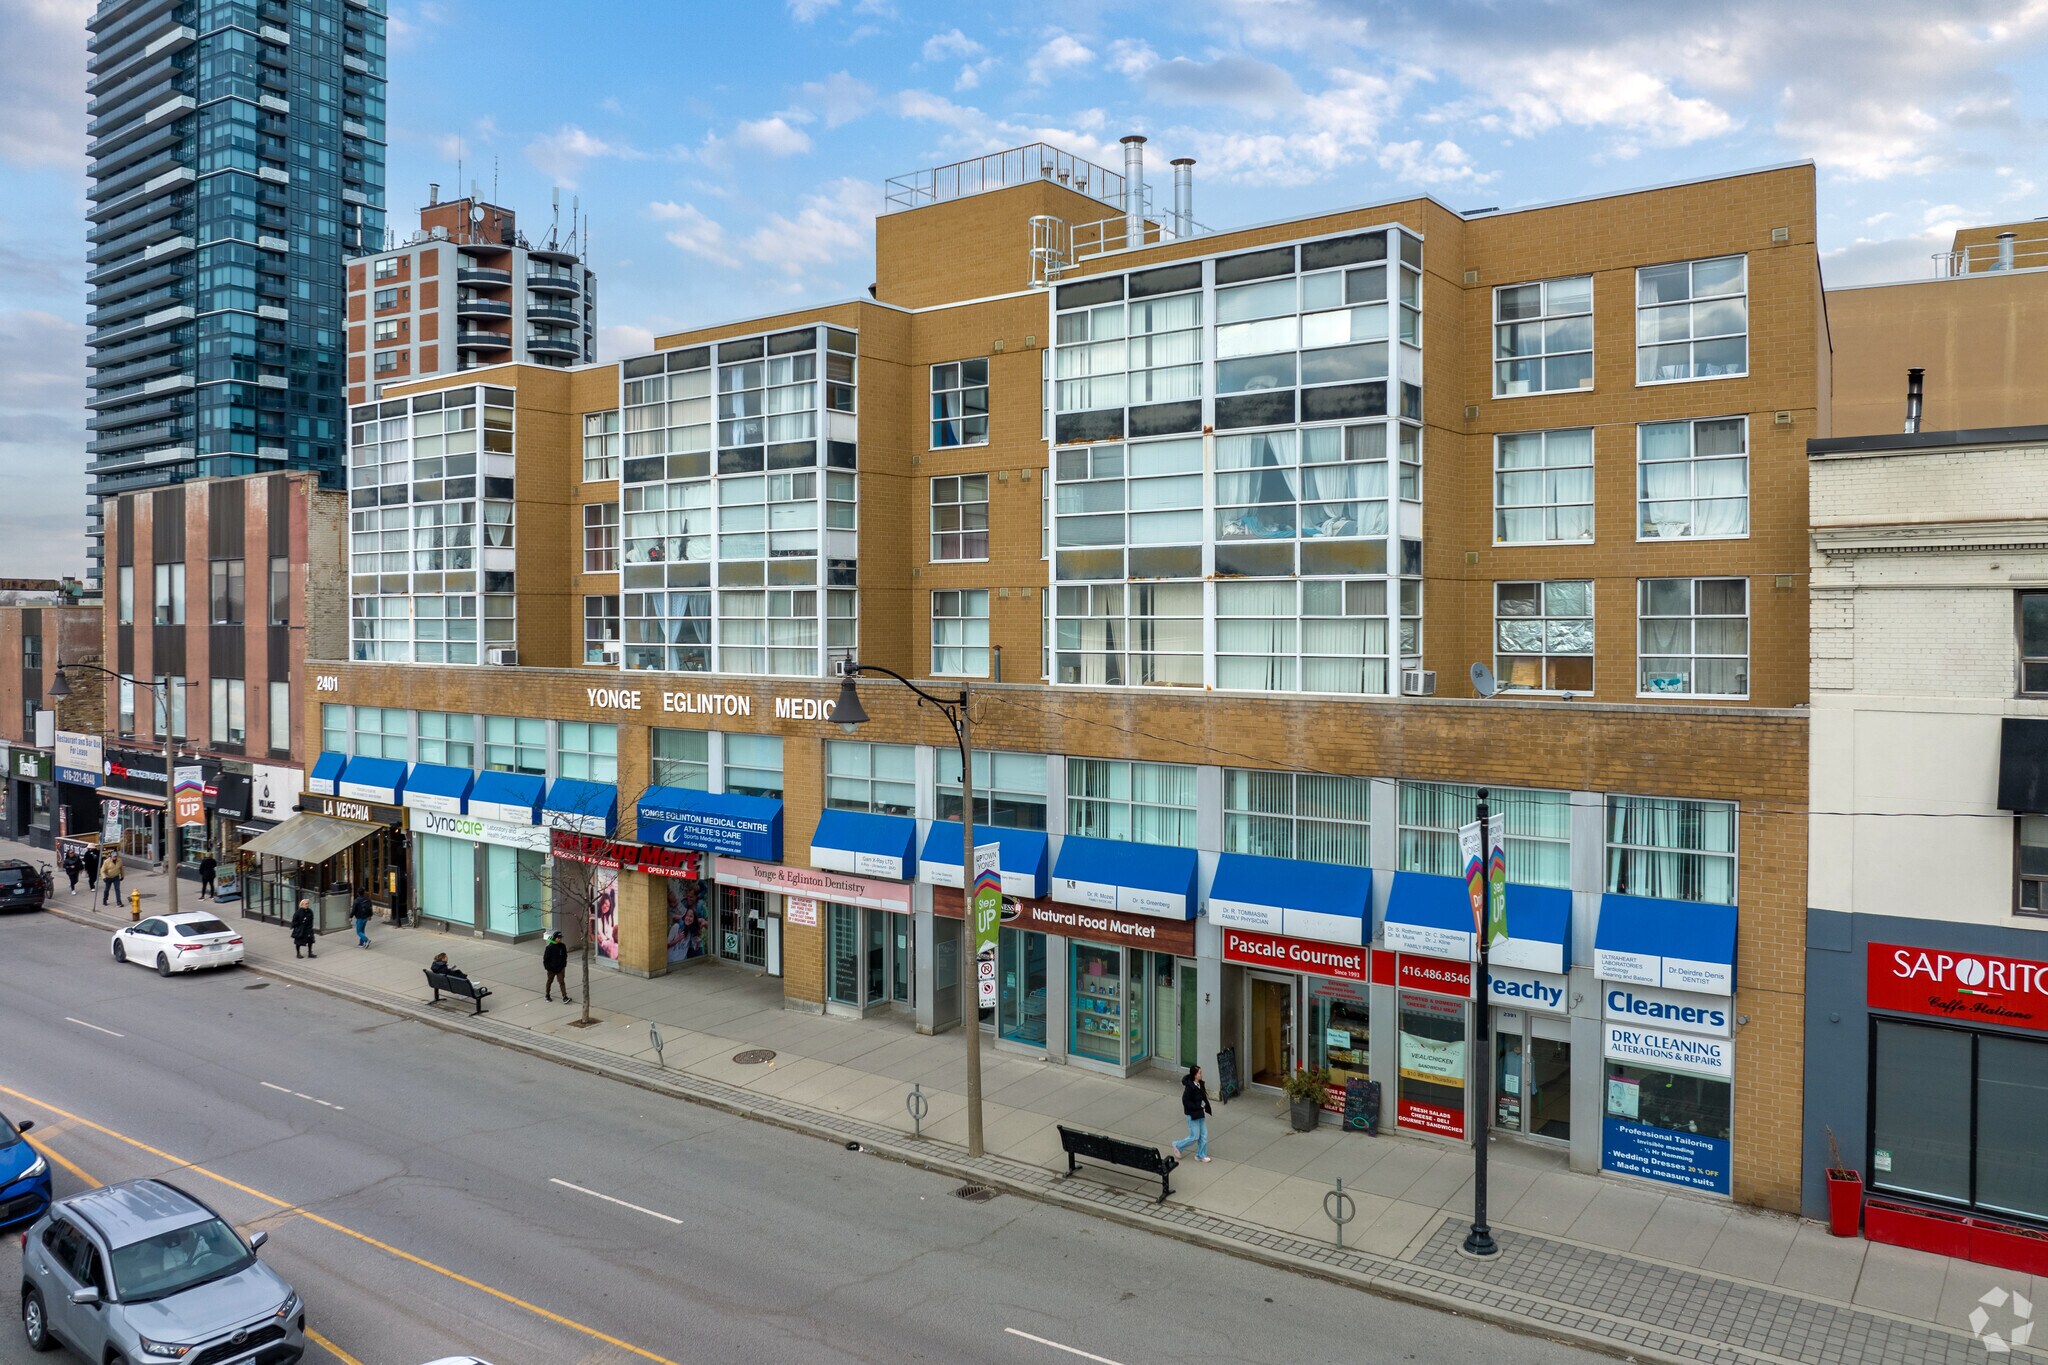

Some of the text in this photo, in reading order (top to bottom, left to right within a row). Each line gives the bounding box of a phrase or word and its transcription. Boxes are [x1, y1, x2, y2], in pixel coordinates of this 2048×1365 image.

[317, 676, 338, 691] 2401
[587, 688, 836, 720] YONGE EGLINTON MEDIC
[180, 803, 200, 816] UP
[258, 799, 276, 809] VILLAGE
[323, 800, 369, 821] LA VECCHIA
[426, 812, 483, 836] Dynacare
[640, 808, 768, 832] YONGE EGLINTON MEDICAL CENTRE
[683, 825, 742, 840] ATHLETE'S CARE
[683, 832, 742, 846] Sports Medicine Centres
[640, 845, 701, 870] Mart
[975, 851, 997, 862] UPTOWN
[977, 860, 996, 870] YONGE
[648, 866, 664, 875] OPEN
[670, 869, 687, 878] DAYS
[753, 865, 866, 896] Yonge & Eglinton Dentistry
[978, 898, 996, 910] Step
[1146, 899, 1170, 908] Greenberg
[1493, 894, 1505, 923] UP
[1237, 909, 1268, 918] TOMMASINI
[978, 908, 997, 933] UP
[1032, 907, 1156, 939] Natural Food Market
[1240, 916, 1269, 925] PHYSICIAN
[1401, 927, 1422, 935] Rothman
[1229, 935, 1361, 970] Pascale Gourmet
[1422, 945, 1448, 953] PRACTICE
[1601, 954, 1637, 963] ULTRAHEART
[1601, 960, 1643, 970] LABORATORIES
[1334, 968, 1360, 978] Since 1993
[1402, 965, 1470, 984] 416.486.8546
[1602, 965, 1629, 974] Cardiology
[1704, 971, 1724, 980] Denis
[1602, 971, 1622, 979] Hearing
[1633, 974, 1653, 982] Balance
[1682, 976, 1710, 985] DENTIST
[1402, 994, 1428, 1002] IMPORTED
[1434, 999, 1462, 1008] DOMESTIC
[1406, 1001, 1427, 1009] CHEESE
[1927, 995, 2033, 1020] Caffe Italiano
[1607, 991, 1725, 1027] Cleaners
[1612, 1030, 1721, 1057] DRY CLEANING
[1411, 1053, 1454, 1065] VEAL/CHICKEN
[1611, 1043, 1673, 1059] ALTERATIONS
[1684, 1054, 1722, 1067] REPAIRS
[1418, 1063, 1447, 1072] SANDWICHES
[1410, 1106, 1451, 1119] FRESH SALADS
[1411, 1112, 1450, 1125] CHEESE DELI
[1398, 1115, 1463, 1133] GOURMET SANDWICHES
[1619, 1125, 1713, 1151] Professional Tailoring
[1637, 1138, 1695, 1155] Invisible mending
[1612, 1150, 1649, 1164] Wedding
[1651, 1157, 1686, 1171] Dresses
[1688, 1165, 1696, 1173] 20
[1705, 1169, 1719, 1177] OFF
[1661, 1151, 1693, 1163] Hemming
[1616, 1161, 1640, 1172] Made
[1652, 1168, 1691, 1182] measure
[1692, 1175, 1715, 1187] suits
